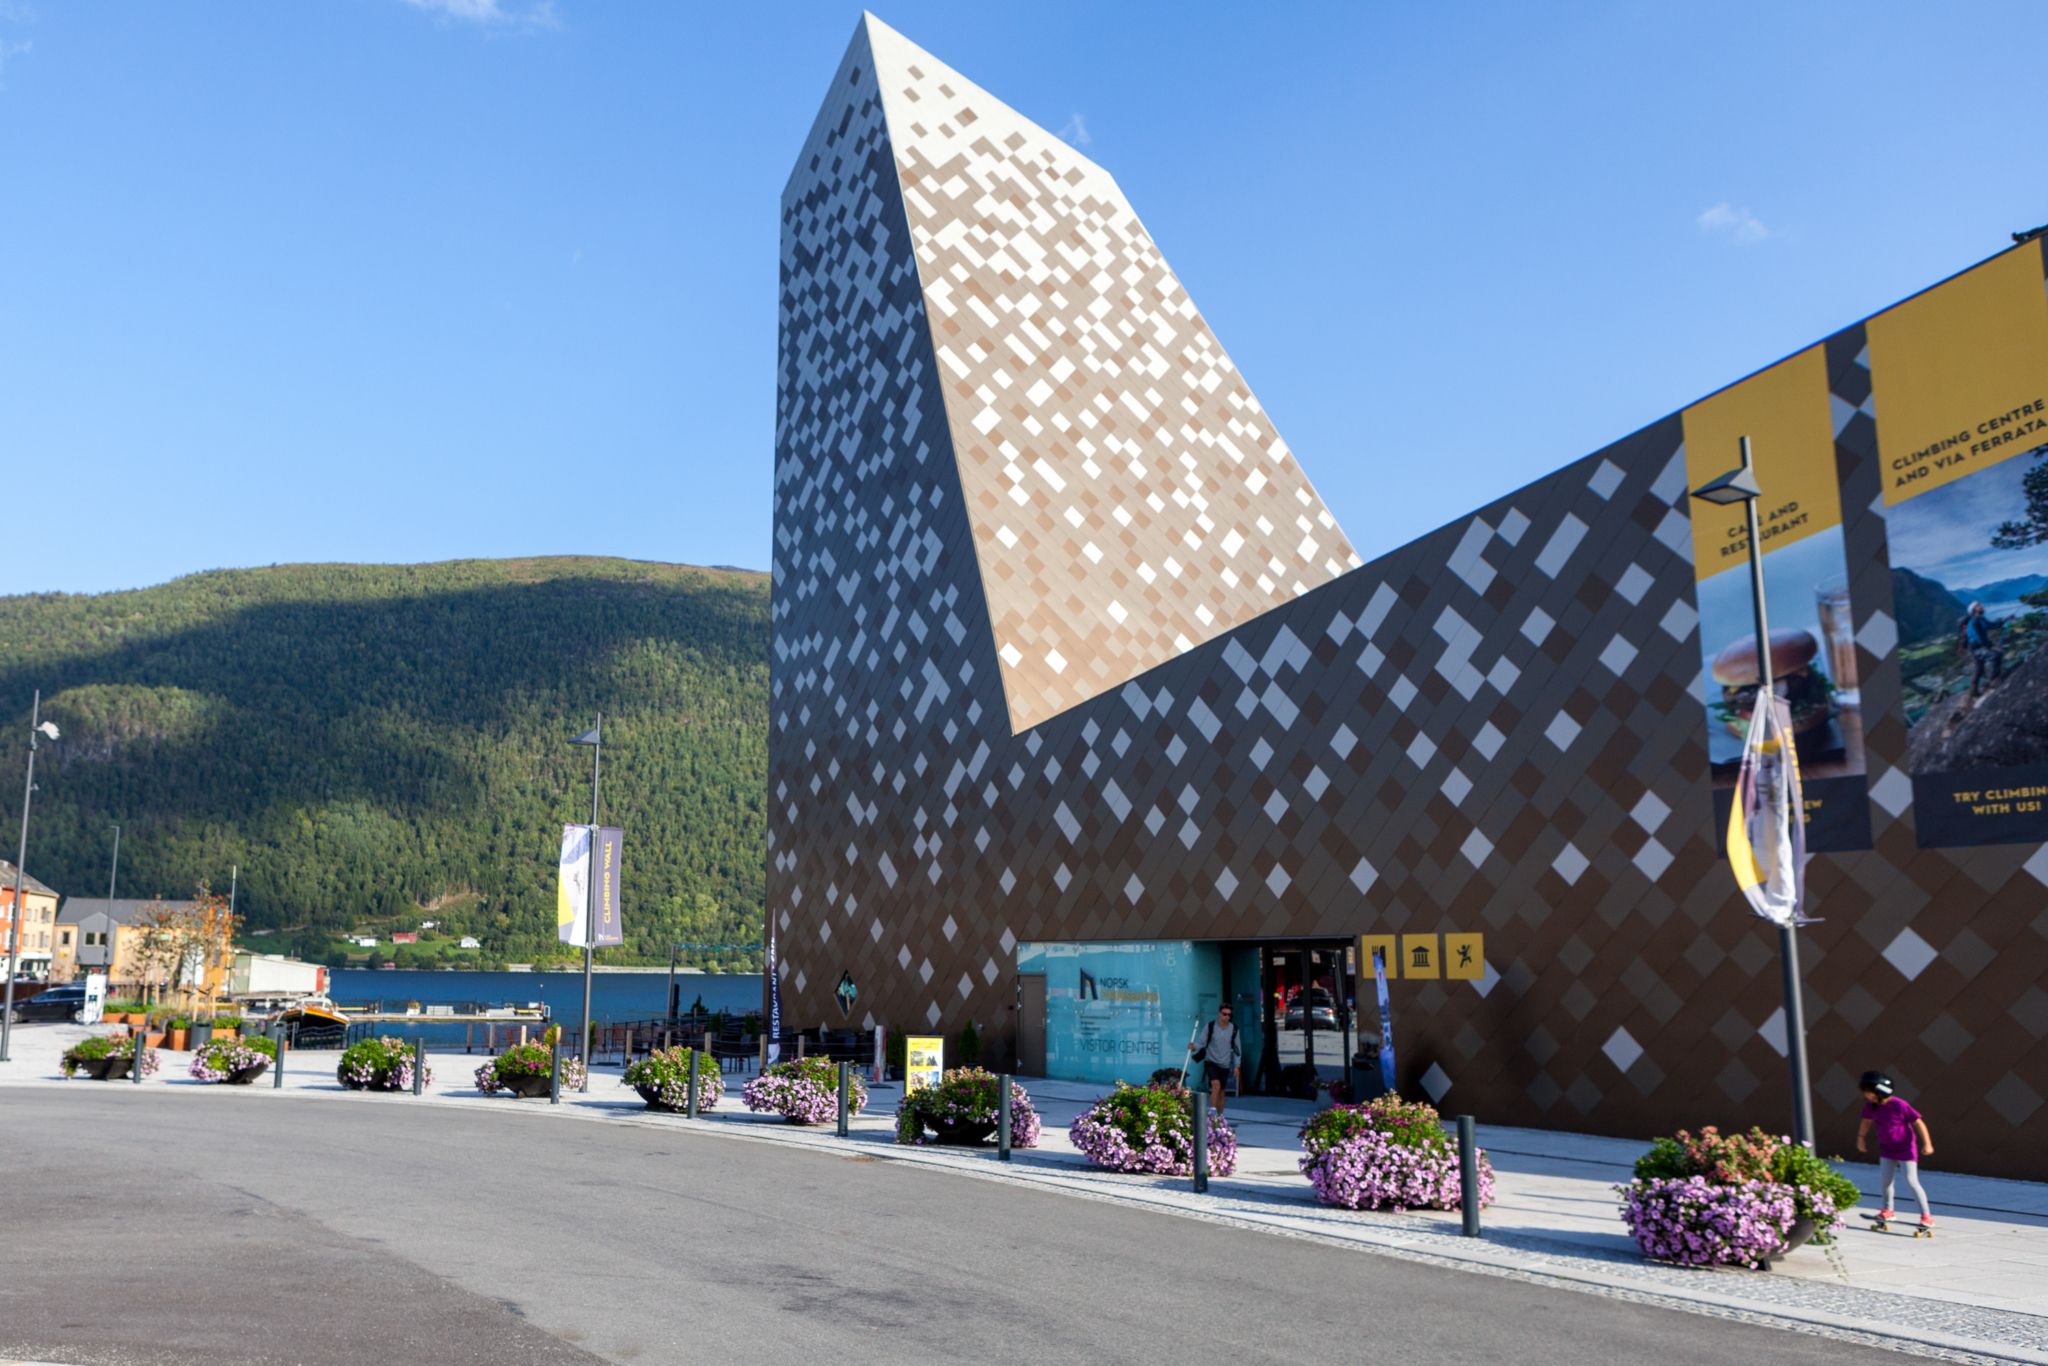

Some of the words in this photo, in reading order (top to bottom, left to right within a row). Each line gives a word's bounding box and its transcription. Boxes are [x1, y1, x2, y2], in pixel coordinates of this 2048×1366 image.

[1892, 430, 1970, 470] CLIMBING
[1977, 399, 2045, 435] CENTRE
[1895, 466, 1930, 487] AND
[1933, 453, 1966, 469] VIA
[1970, 418, 2048, 456] FERRATA
[1721, 512, 1808, 557] RESURANT
[1728, 514, 1763, 538] CAE
[1769, 501, 1799, 522] AND
[1953, 791, 1980, 803] TRY
[1985, 786, 2048, 800] CLIMBIN
[1972, 803, 2010, 814] WITH
[2016, 801, 2041, 812] US!
[604, 841, 612, 869] WALL
[1080, 1039, 1116, 1053] VISITOR
[1119, 1040, 1160, 1056] CENTRE
